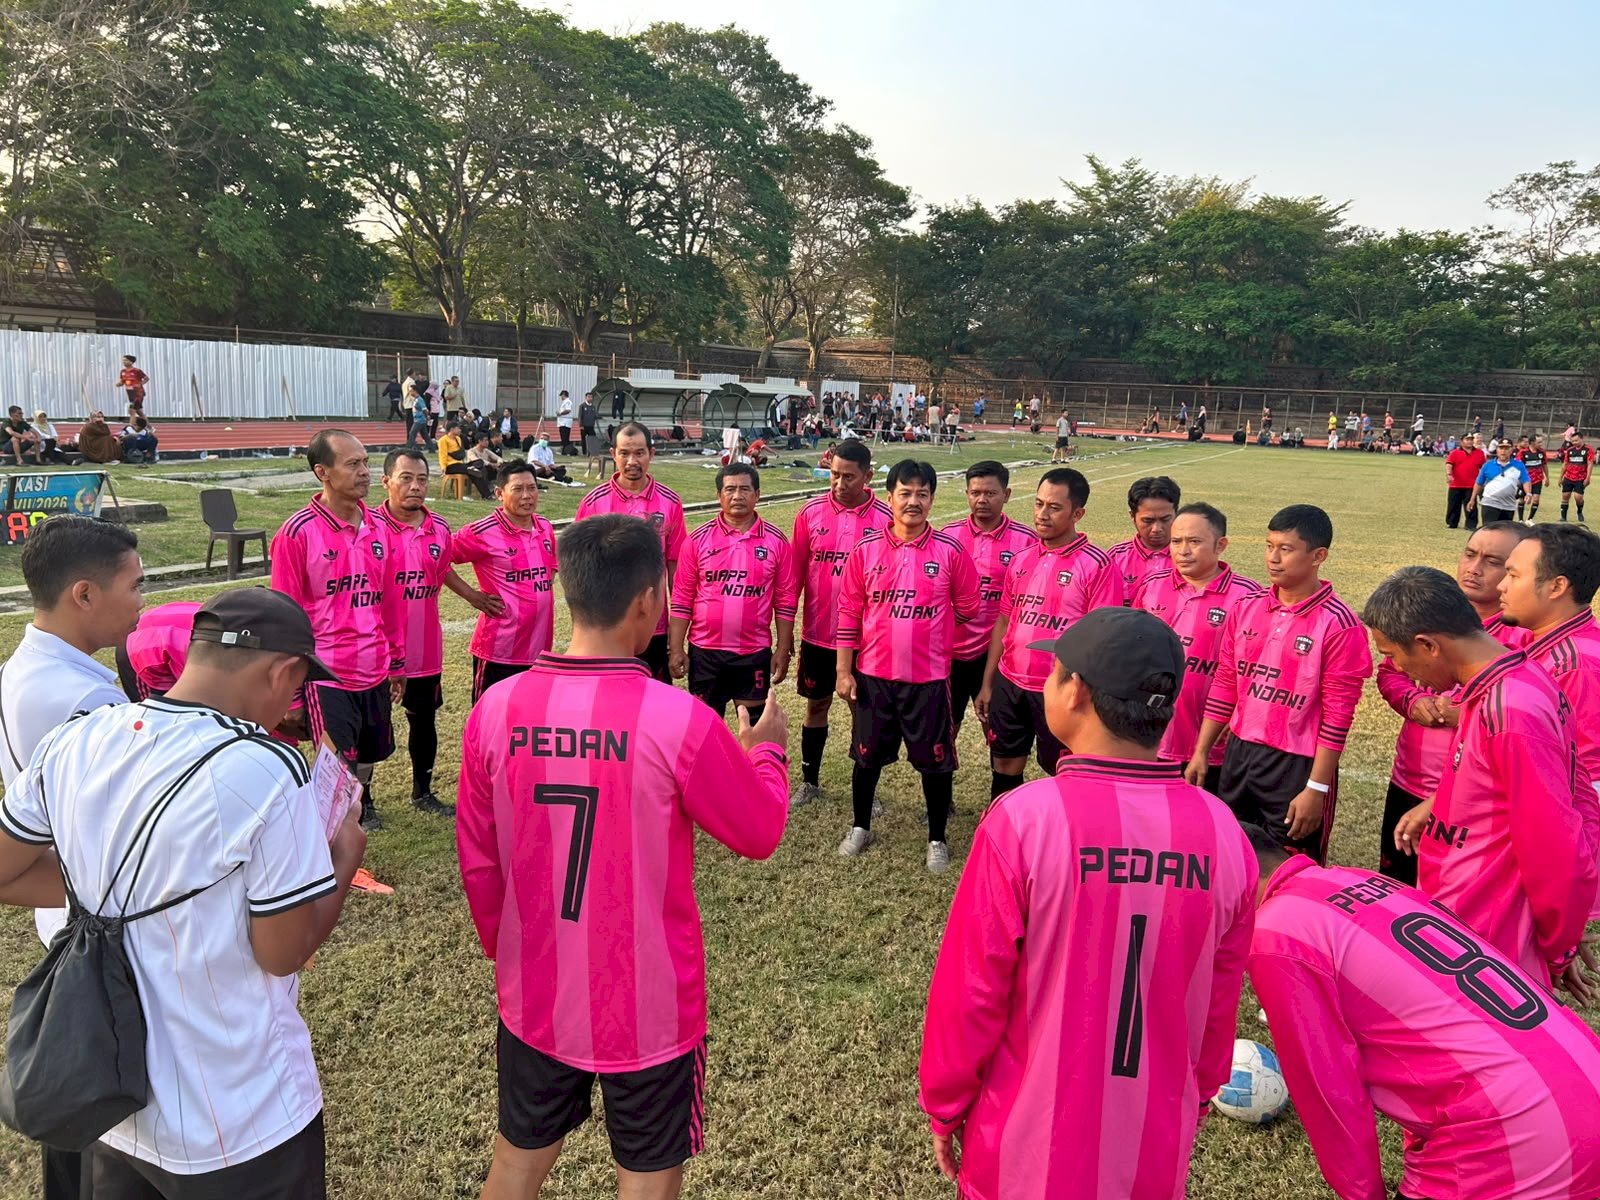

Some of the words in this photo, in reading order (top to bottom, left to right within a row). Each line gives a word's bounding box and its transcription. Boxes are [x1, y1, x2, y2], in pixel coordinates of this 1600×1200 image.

[4, 496, 68, 510] VII/2026
[395, 571, 425, 585] APP
[506, 567, 547, 582] SIAPP
[705, 570, 747, 582] SIAPP
[872, 590, 917, 603] SIAPP
[889, 605, 938, 619] NDAN!
[755, 670, 764, 688] 5
[1247, 682, 1306, 710] NDAN!
[509, 726, 628, 762] PEDAN
[533, 783, 600, 923] 7
[1079, 847, 1210, 891] PEDAN
